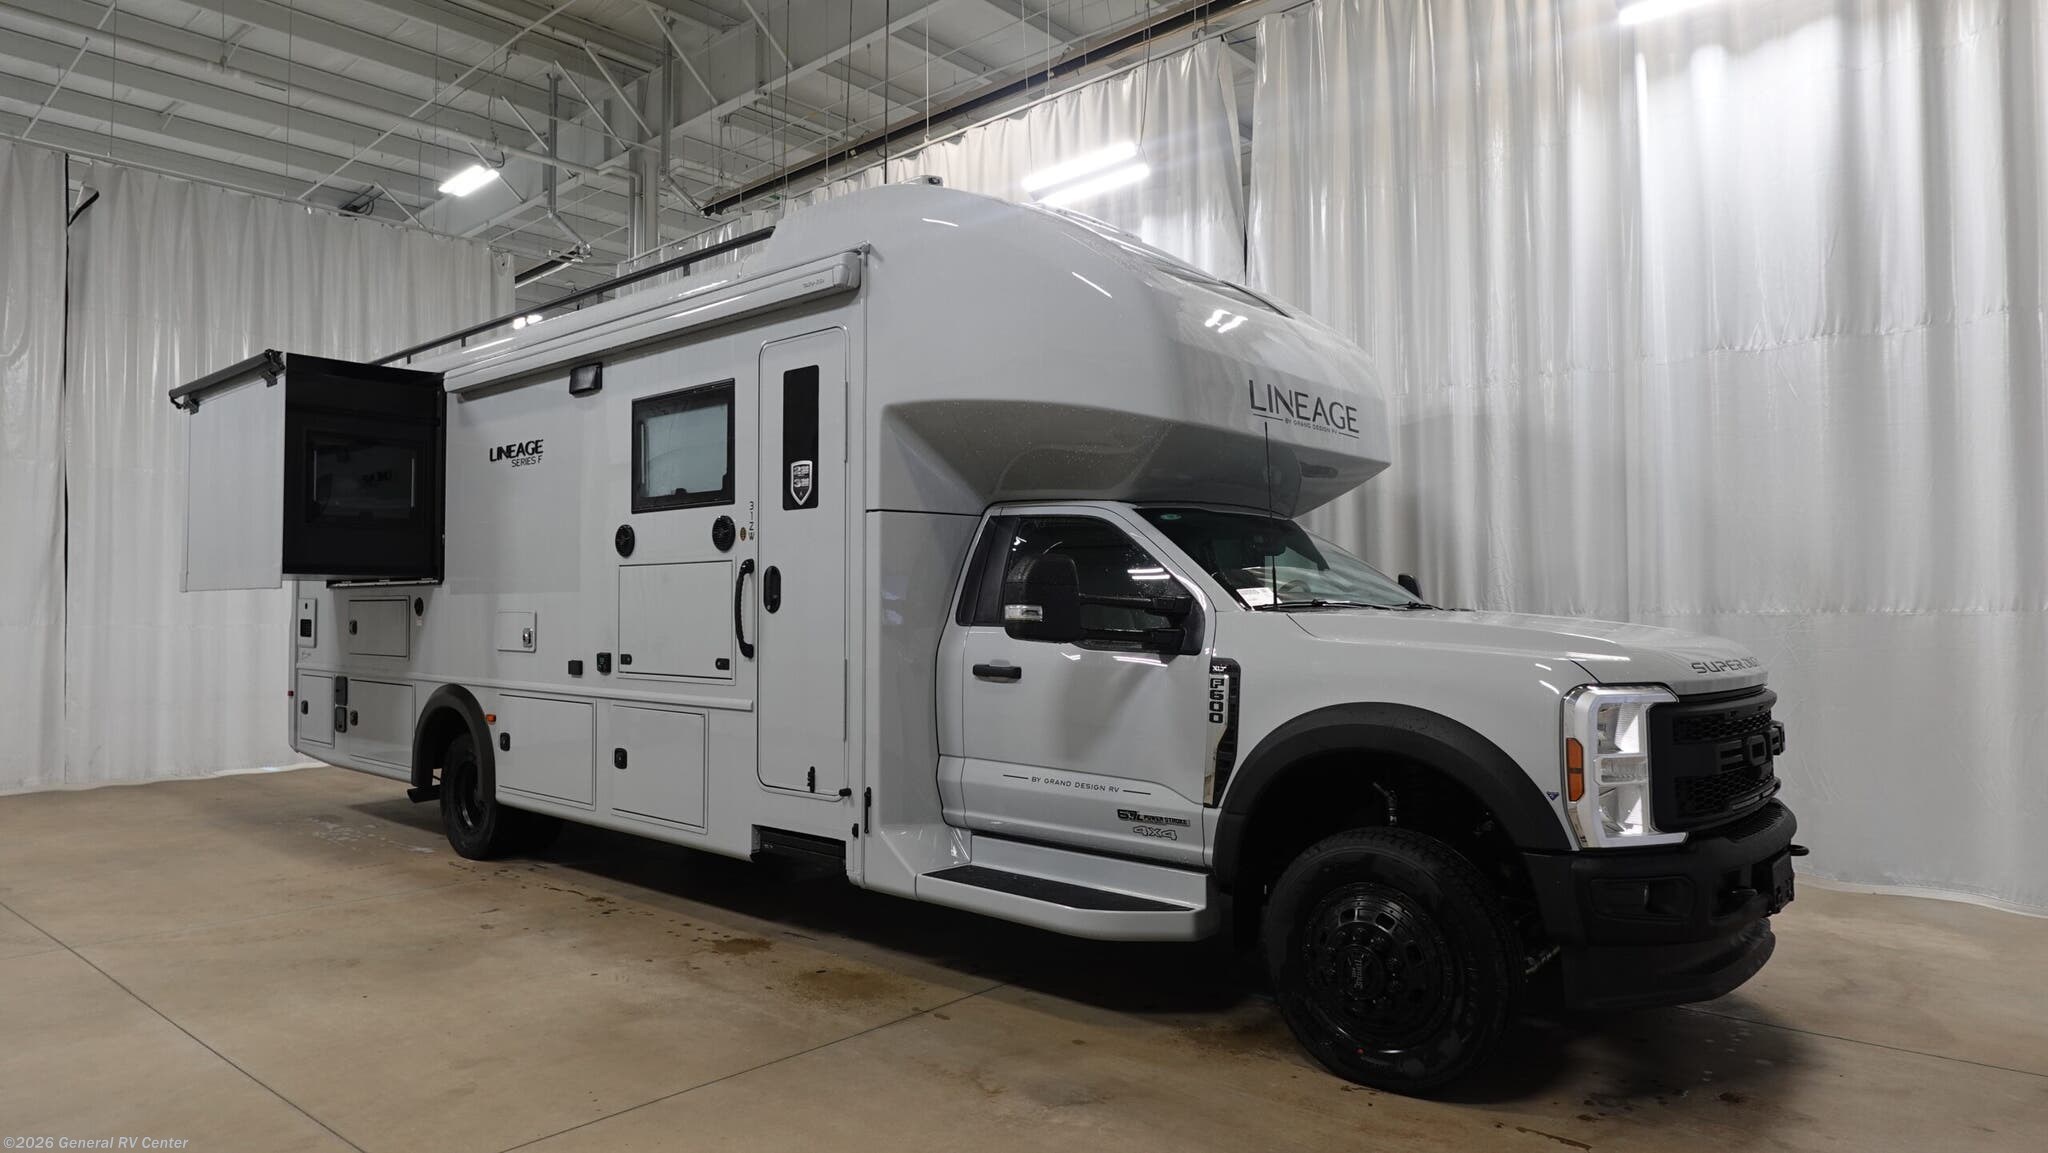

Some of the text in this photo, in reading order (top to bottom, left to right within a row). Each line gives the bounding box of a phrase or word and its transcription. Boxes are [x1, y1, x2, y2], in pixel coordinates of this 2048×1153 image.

[1248, 379, 1360, 433] LINEAGE
[489, 438, 544, 462] LINEAGE
[511, 454, 543, 468] SERIES F
[1212, 664, 1227, 672] XLT
[1691, 659, 1746, 674] SUPER
[1208, 677, 1224, 724] F600
[1043, 777, 1072, 788] GRAND
[1074, 781, 1106, 791] DESIGN
[1108, 785, 1120, 793] RV
